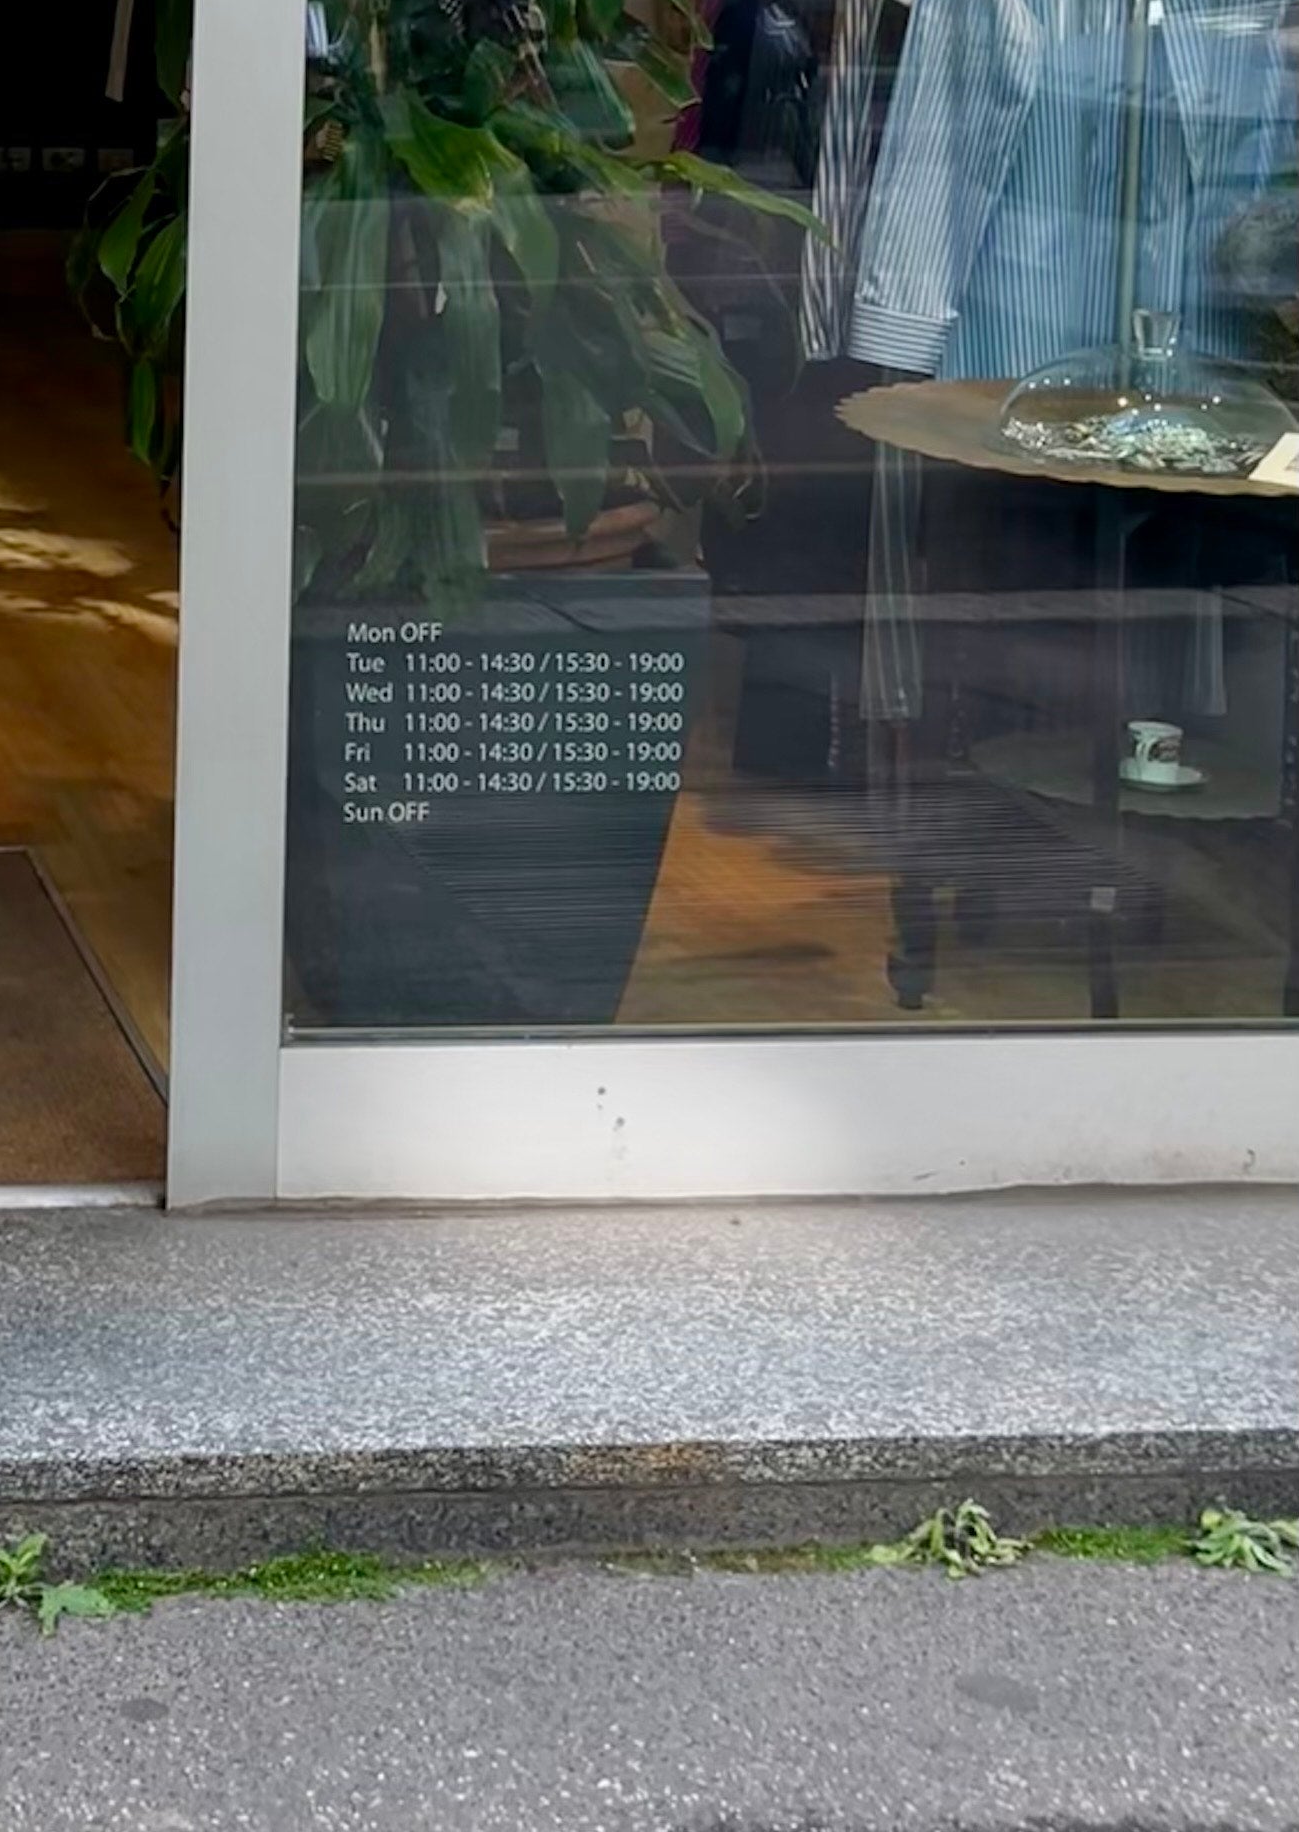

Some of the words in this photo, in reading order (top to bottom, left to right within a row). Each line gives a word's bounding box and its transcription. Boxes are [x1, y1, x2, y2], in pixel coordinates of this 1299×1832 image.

[347, 622, 396, 643] Mon
[399, 621, 443, 643] OFF
[346, 652, 386, 673] Tue
[405, 652, 461, 673] 11:00
[480, 652, 535, 673] 14:30
[539, 652, 551, 673] /
[555, 652, 611, 673] 15:30
[629, 652, 685, 673] 19:00
[345, 681, 394, 703] Wed
[407, 682, 462, 703] 11:00
[480, 682, 536, 703] 14:30
[538, 682, 550, 703] /
[555, 682, 611, 703] 15:30
[629, 682, 684, 703] 19:00
[344, 711, 386, 733] Thu
[405, 712, 461, 733] 11:00
[479, 712, 535, 733] 14:30
[537, 712, 549, 733] /
[554, 712, 610, 733] 15:30
[628, 712, 683, 733] 19:00
[344, 741, 371, 762] Fri
[404, 742, 460, 763] 11:00
[479, 742, 534, 763] 14:30
[536, 742, 549, 762] /
[553, 741, 609, 762] 15:30
[626, 741, 682, 762] 19:00
[344, 771, 377, 793] Sat
[404, 772, 459, 793] 11:00
[478, 772, 533, 792] 14:30
[535, 771, 547, 792] /
[552, 771, 608, 792] 15:30
[626, 771, 681, 792] 19:00
[342, 801, 384, 823] Sun
[387, 801, 430, 824] OFF
